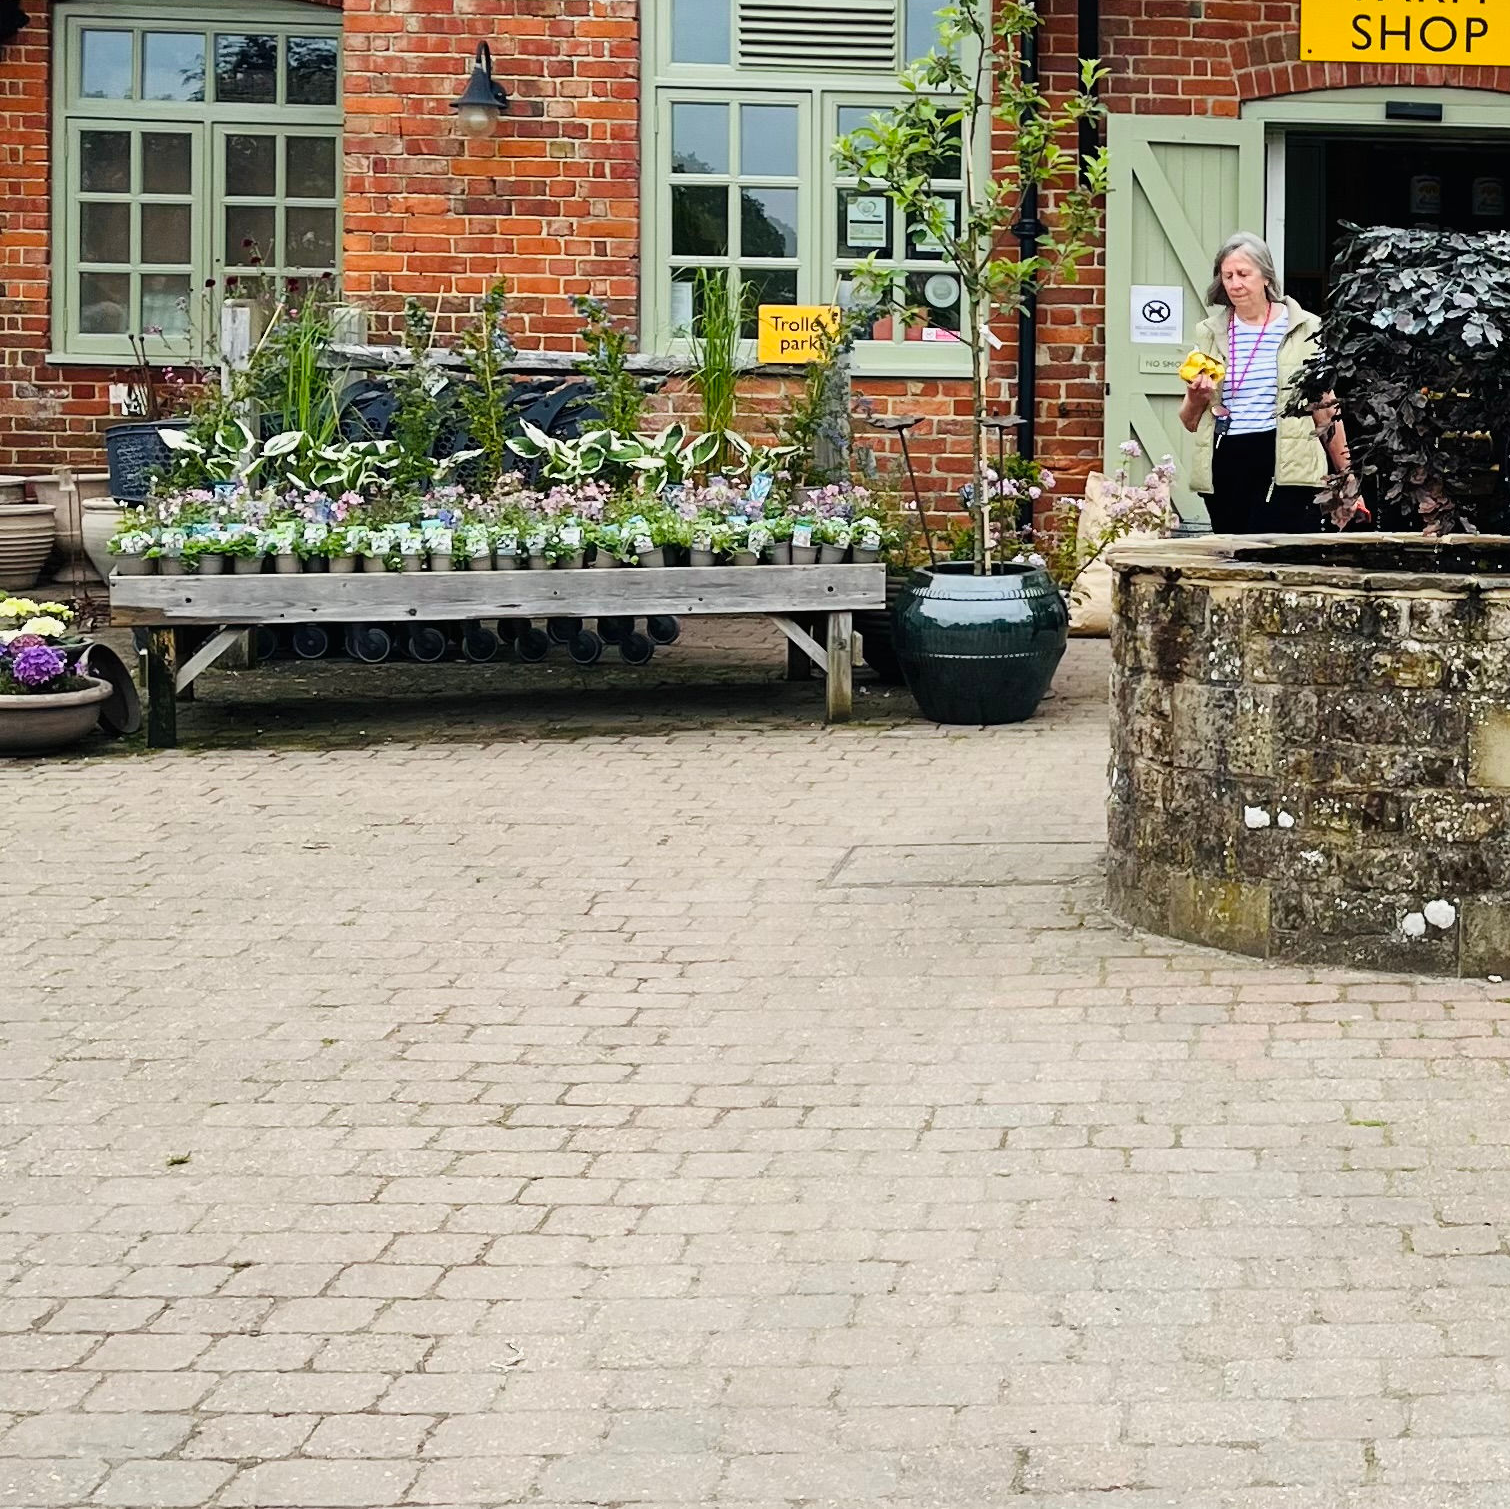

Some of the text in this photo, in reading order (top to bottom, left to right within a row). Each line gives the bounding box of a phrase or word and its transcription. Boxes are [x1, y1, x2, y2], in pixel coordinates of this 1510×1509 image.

[1351, 14, 1489, 53] SHOP
[780, 335, 819, 354] park
[1145, 360, 1160, 368] NO
